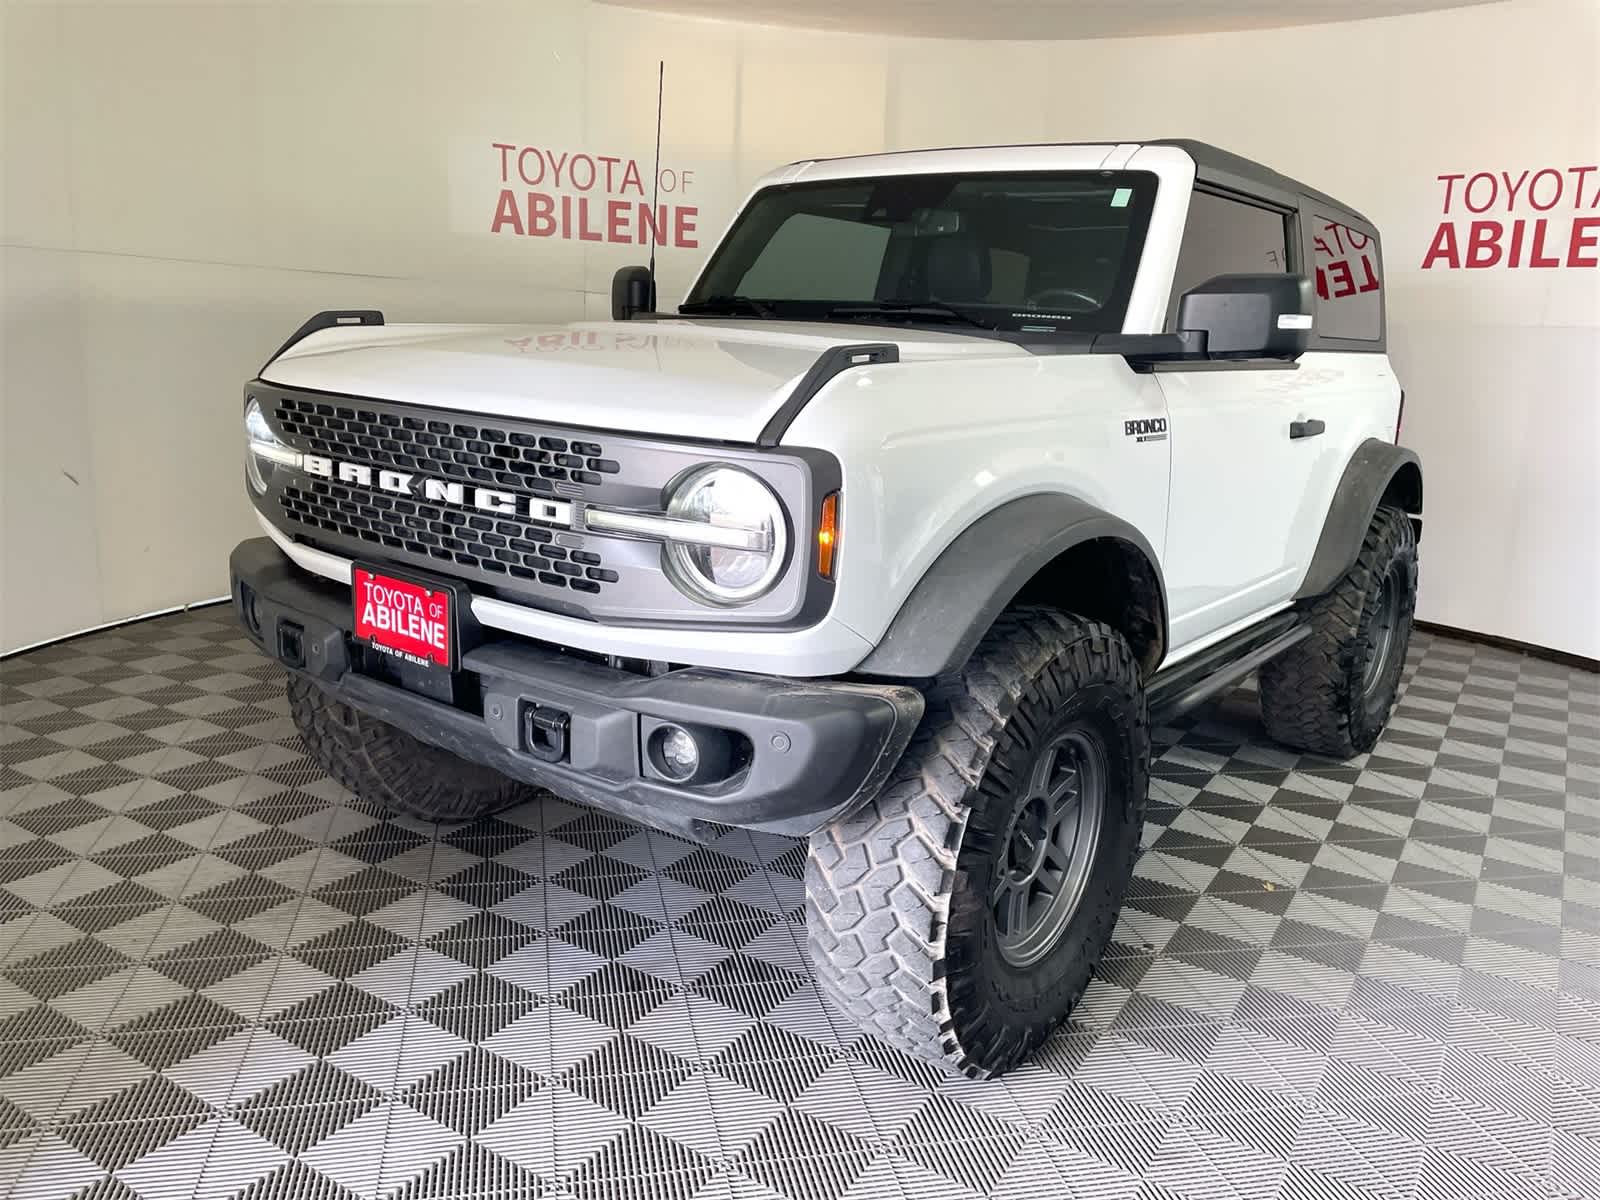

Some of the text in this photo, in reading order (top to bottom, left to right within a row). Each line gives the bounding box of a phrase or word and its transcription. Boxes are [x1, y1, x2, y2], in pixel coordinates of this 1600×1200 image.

[492, 143, 694, 195] TOYOTA OF
[491, 189, 698, 248] ABILENE
[1124, 418, 1167, 436] BRONCO
[303, 454, 576, 525] BRONCO
[364, 582, 443, 619] TOYOTA OF
[362, 602, 445, 649] ABILENE
[371, 642, 429, 667] TOYOTA OF ABILENE
